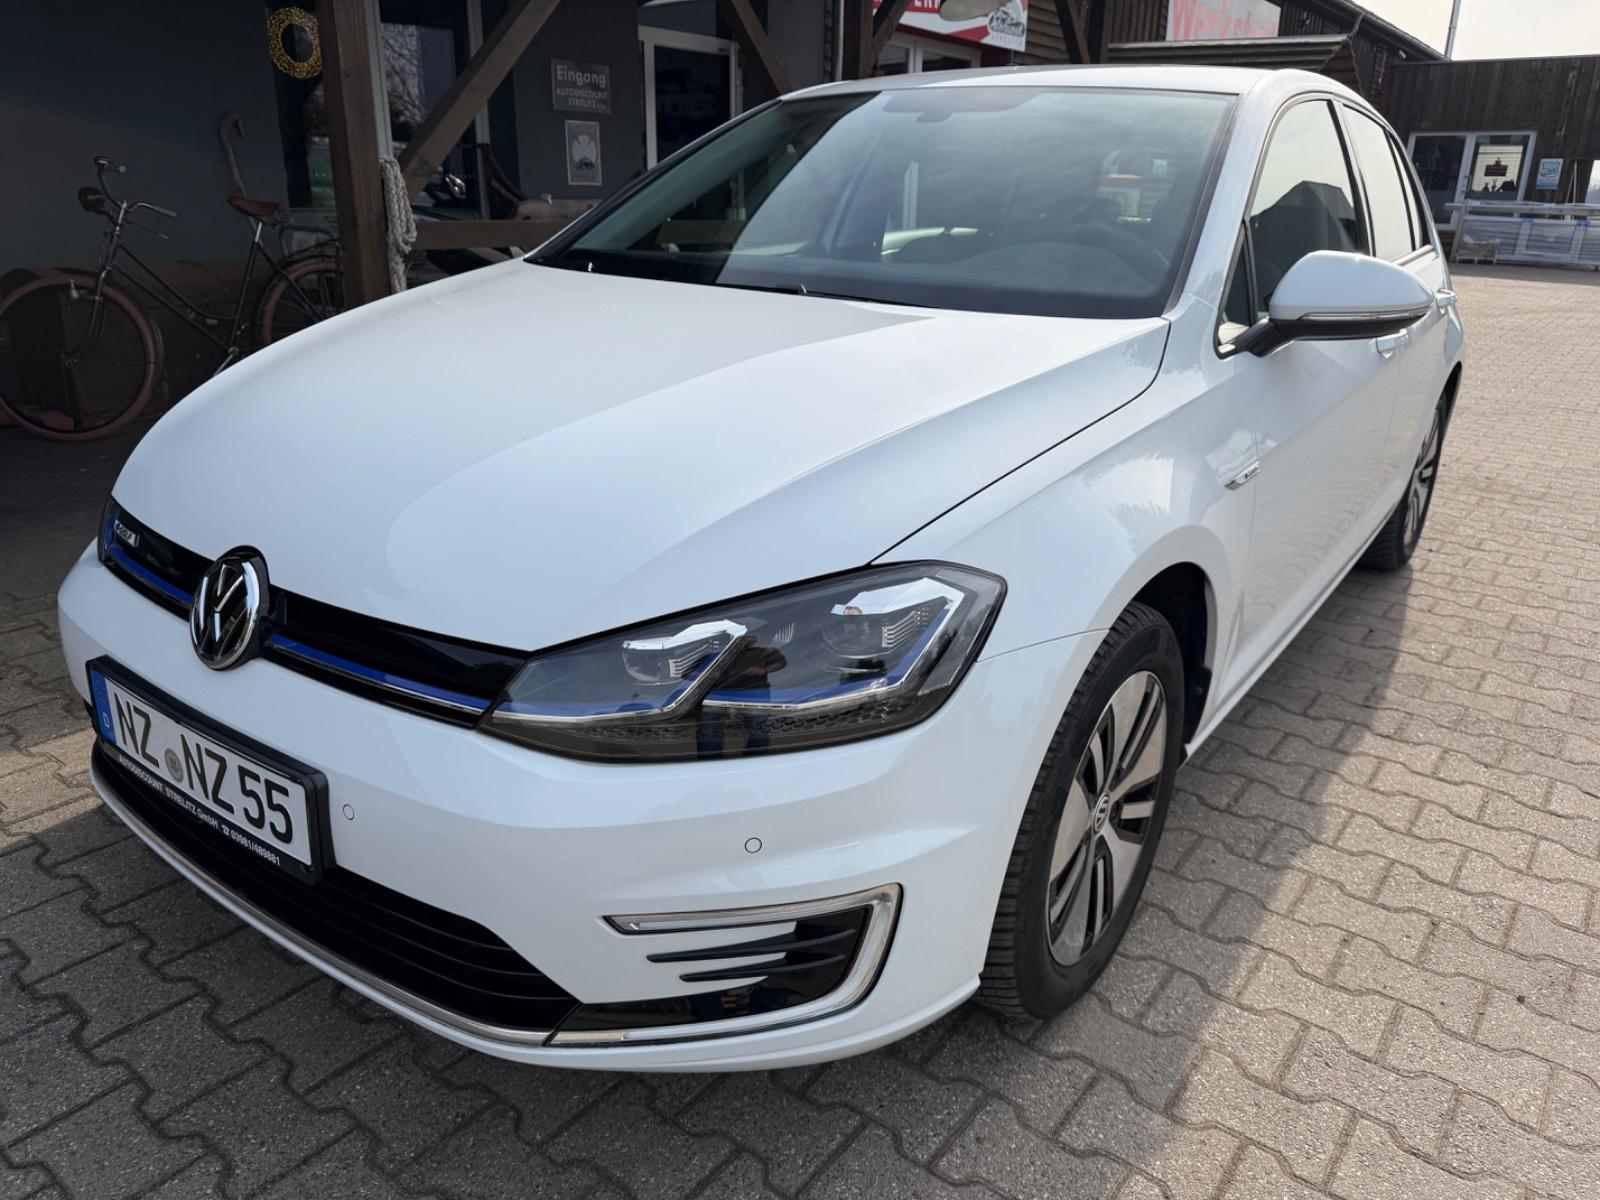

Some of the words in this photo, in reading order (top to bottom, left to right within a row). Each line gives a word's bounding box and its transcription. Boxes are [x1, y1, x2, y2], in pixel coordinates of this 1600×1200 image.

[556, 64, 607, 88] Eingang
[114, 691, 160, 768] NZ
[180, 733, 235, 815] NZ
[237, 764, 293, 844] 55
[165, 787, 198, 815] STRELITZ
